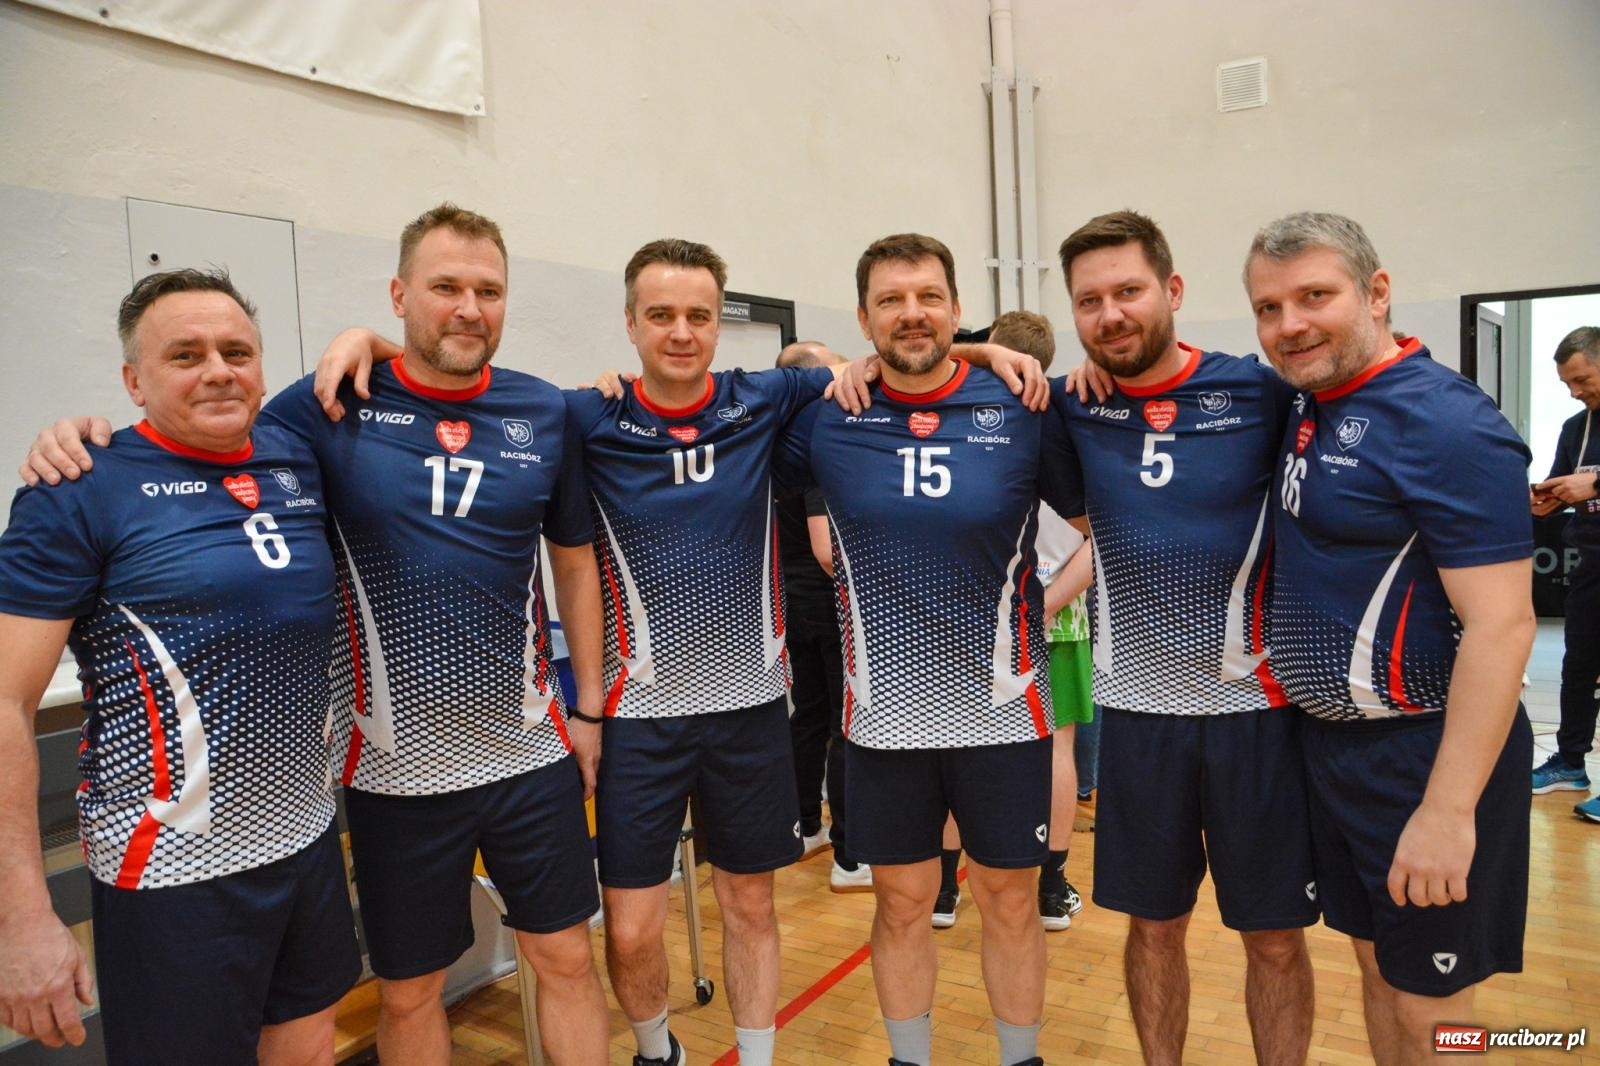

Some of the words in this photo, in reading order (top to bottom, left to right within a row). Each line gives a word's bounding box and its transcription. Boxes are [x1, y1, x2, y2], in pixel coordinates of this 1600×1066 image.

[967, 434, 1011, 444] RACIBÓRZ
[1195, 416, 1242, 430] RACIBÓRZ
[500, 451, 542, 463] RACIBÓRZ
[896, 446, 952, 498] 15
[1139, 432, 1176, 488] 5
[424, 455, 485, 518] 17
[242, 512, 292, 569] 6
